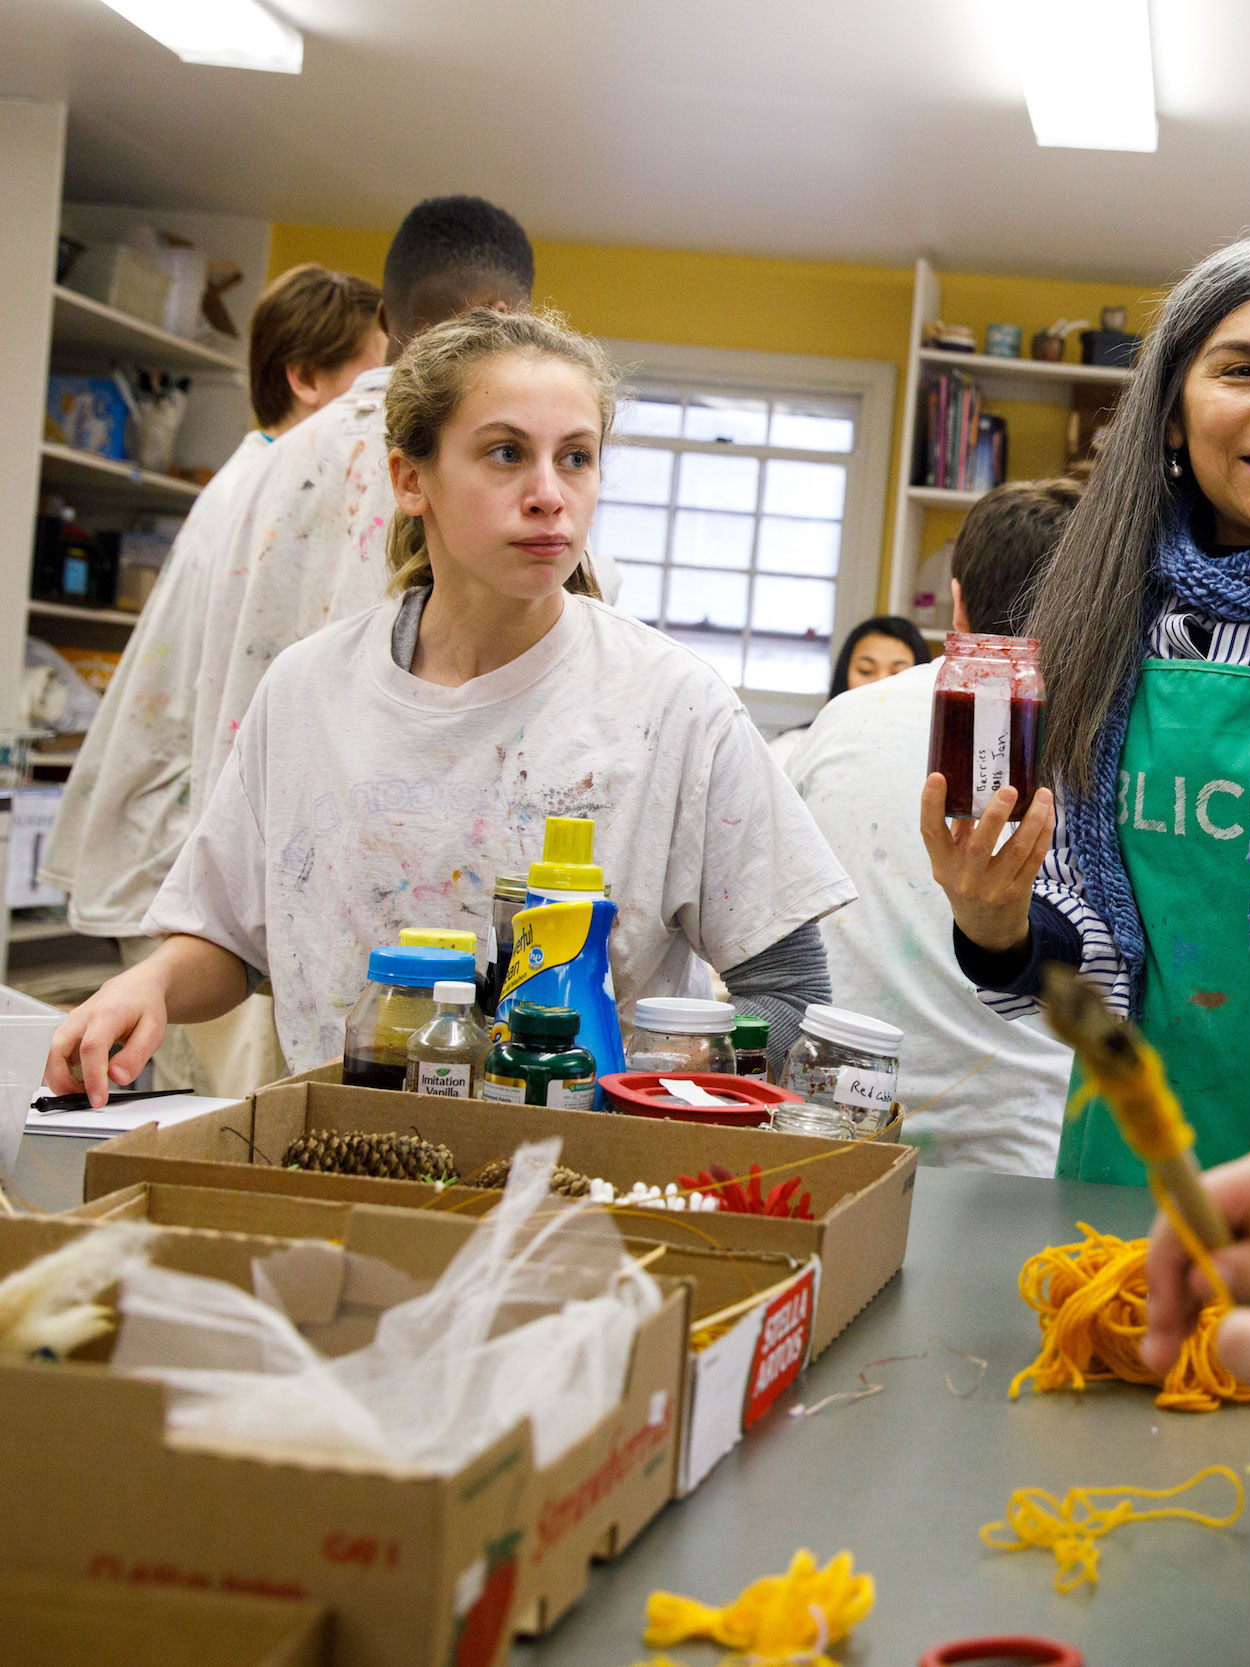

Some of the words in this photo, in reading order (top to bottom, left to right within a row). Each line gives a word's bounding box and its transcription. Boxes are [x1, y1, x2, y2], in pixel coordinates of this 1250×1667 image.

[421, 1074, 466, 1087] Imitation
[850, 1080, 874, 1099] Red
[426, 1087, 459, 1098] Vanilla
[761, 1287, 808, 1355] STELLA
[752, 1325, 804, 1399] ARTOIS
